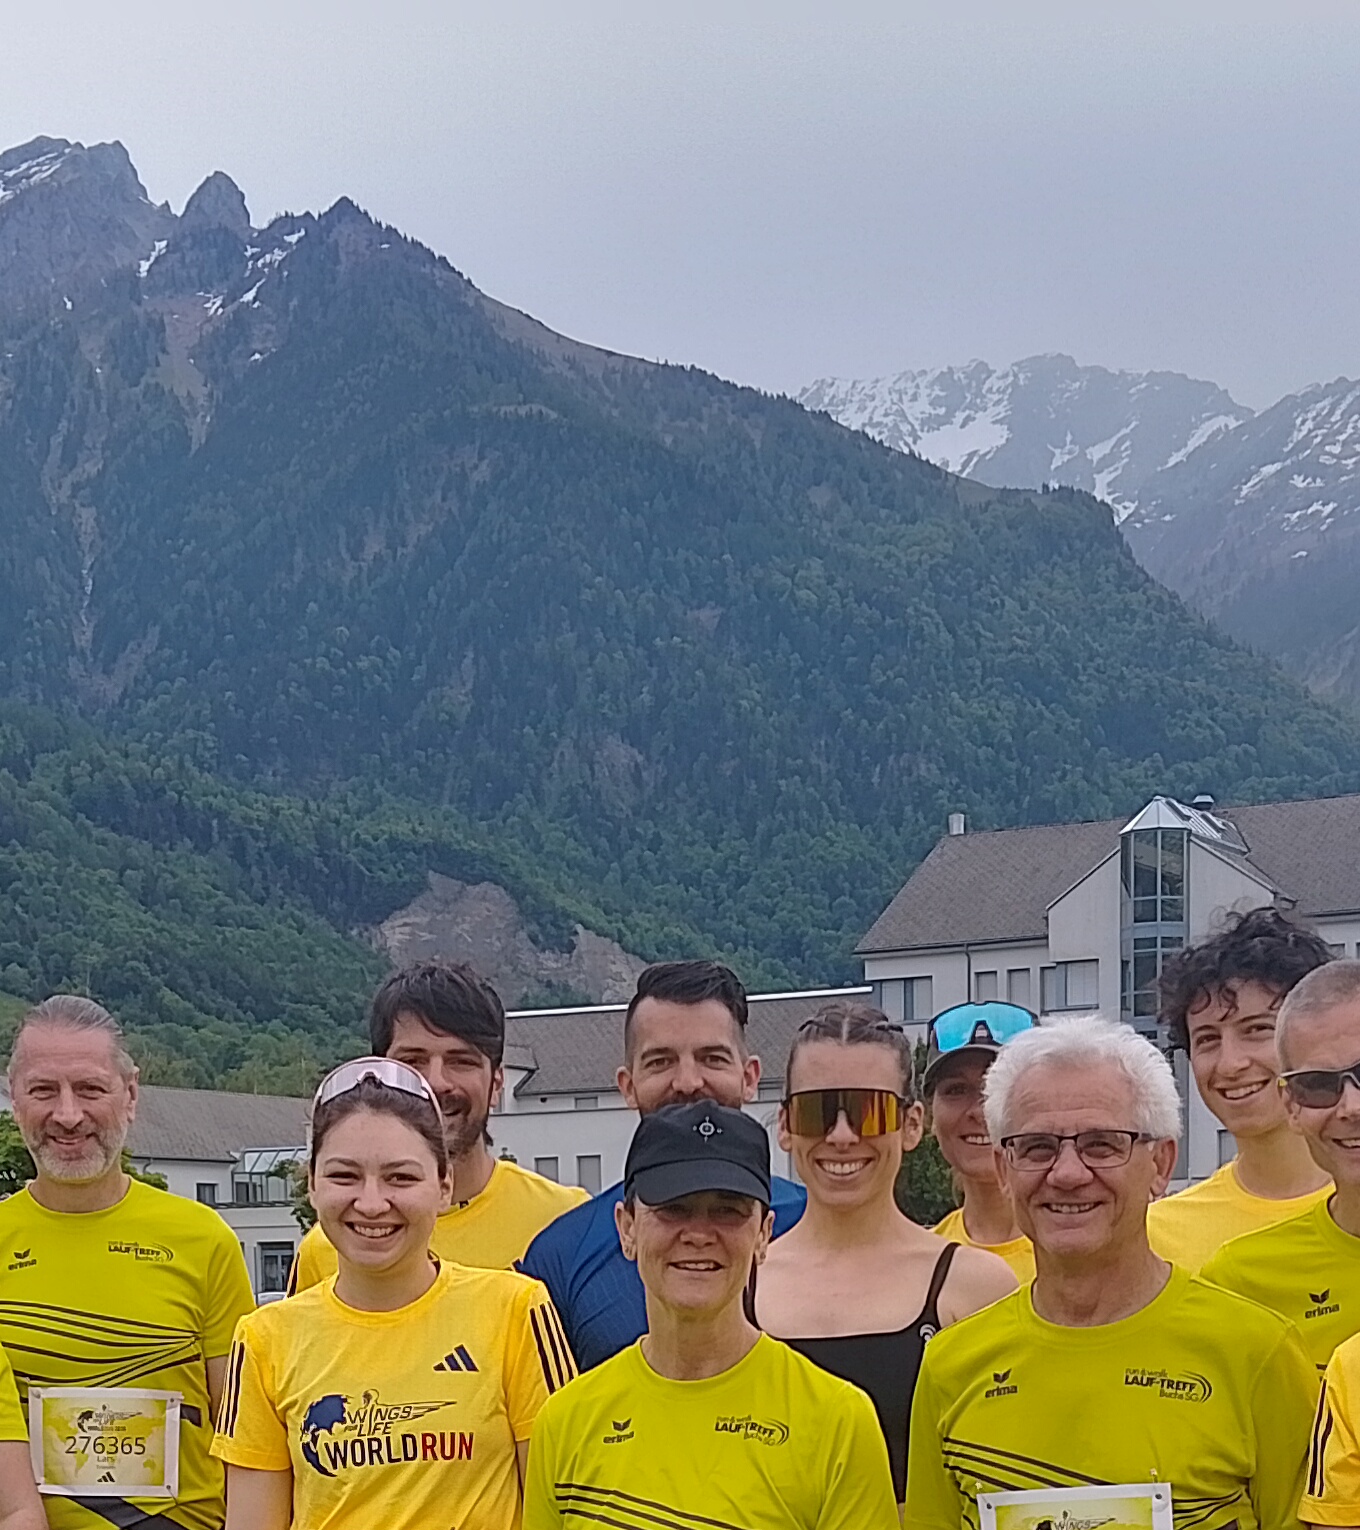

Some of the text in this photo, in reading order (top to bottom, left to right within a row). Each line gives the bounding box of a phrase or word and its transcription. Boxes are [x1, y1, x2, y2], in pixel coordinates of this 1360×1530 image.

[1305, 1304, 1340, 1319] erima
[985, 1384, 1018, 1398] erima
[1125, 1375, 1197, 1392] LAUF-TREFF
[346, 1405, 413, 1424] WINGS
[357, 1421, 395, 1437] LIFE
[65, 1436, 146, 1455] 276365
[324, 1432, 474, 1470] WORLD RUN
